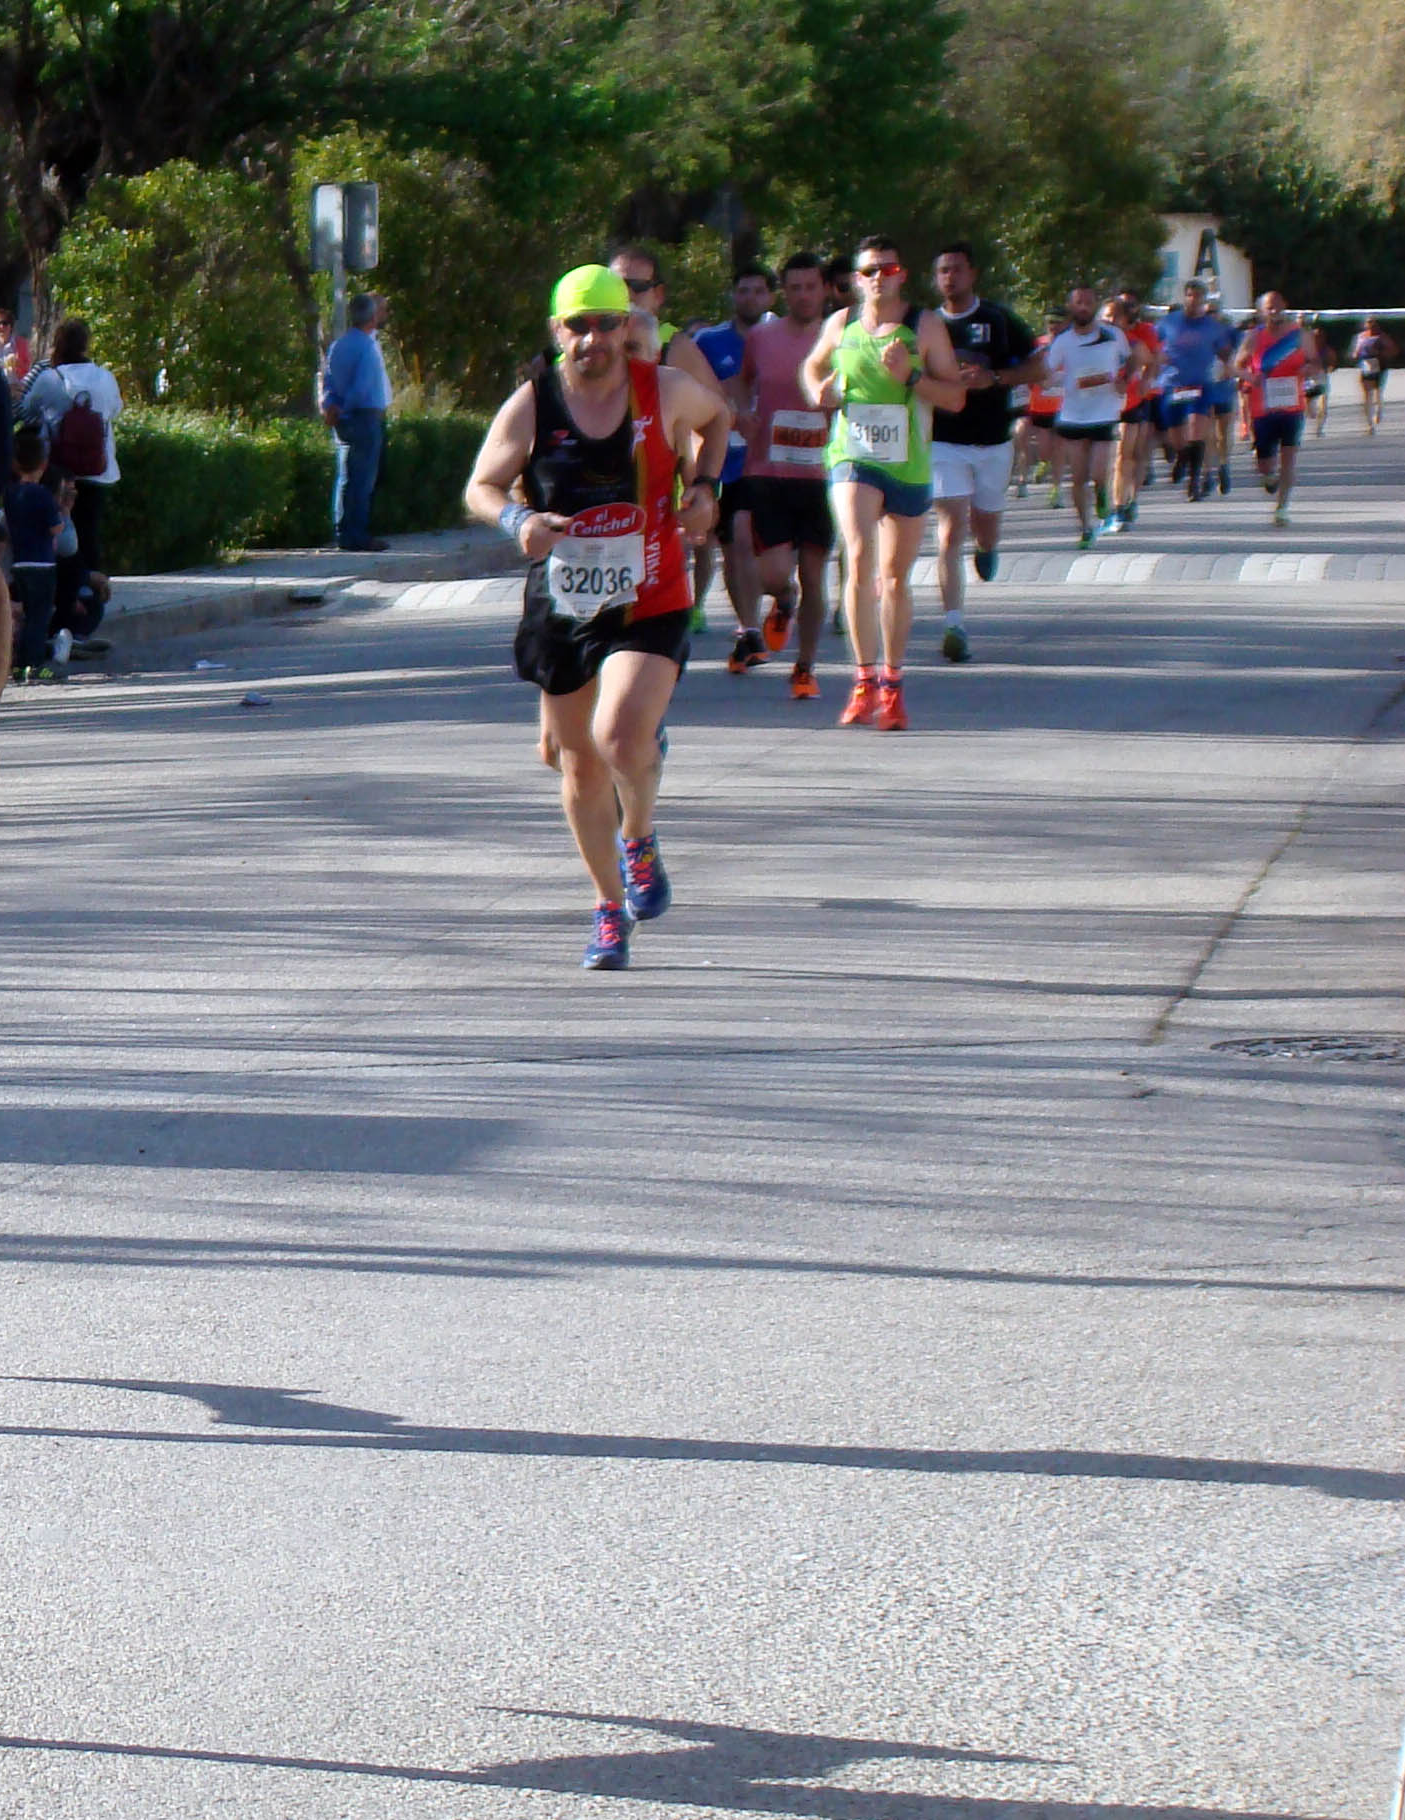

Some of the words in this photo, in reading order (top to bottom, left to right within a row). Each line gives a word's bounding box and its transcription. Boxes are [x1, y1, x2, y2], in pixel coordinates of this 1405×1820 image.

[854, 423, 900, 443] 31901
[570, 511, 636, 536] Conchel
[596, 509, 608, 522] el
[561, 566, 632, 594] 32036
